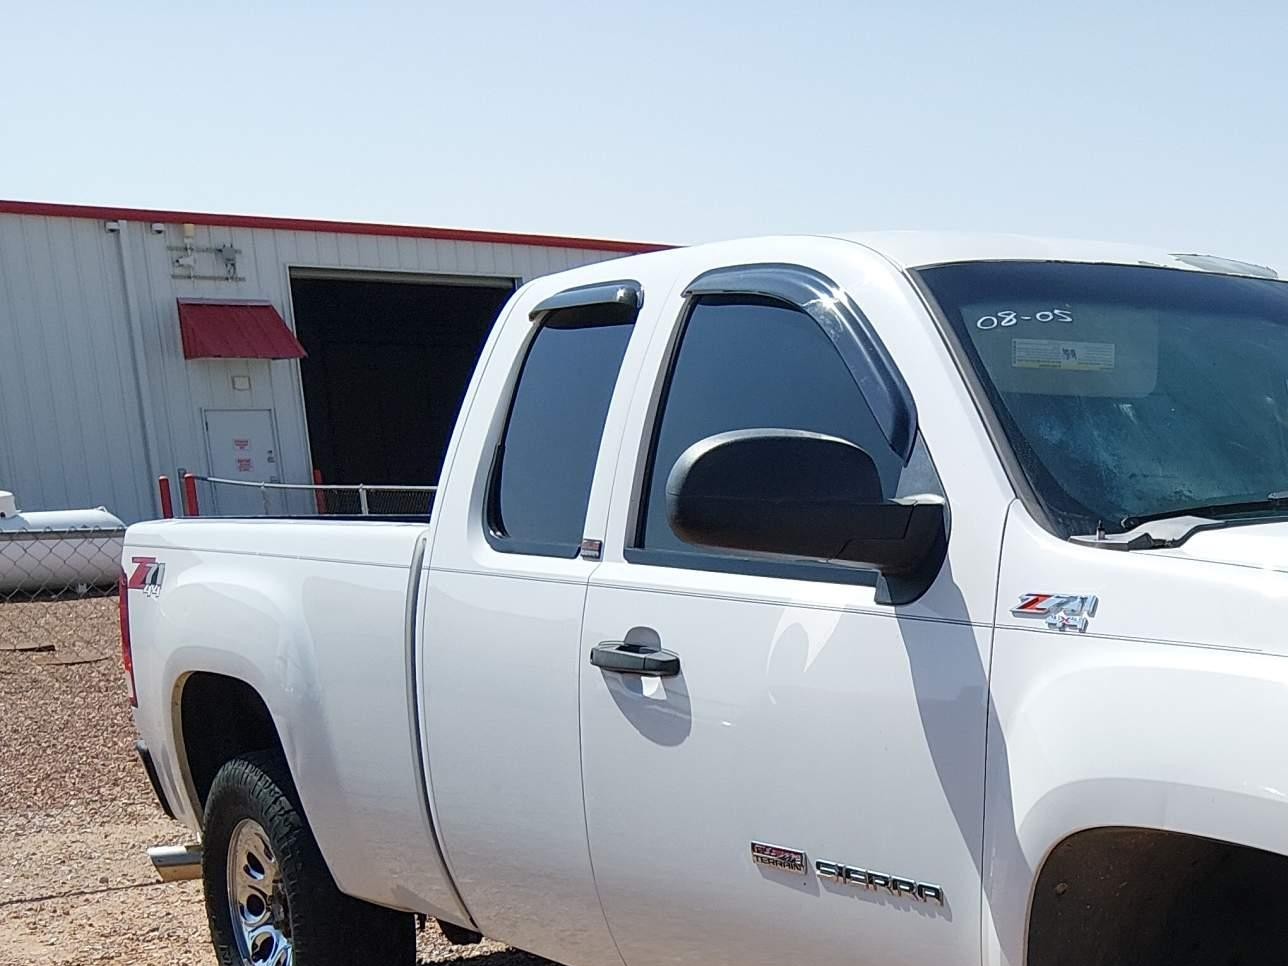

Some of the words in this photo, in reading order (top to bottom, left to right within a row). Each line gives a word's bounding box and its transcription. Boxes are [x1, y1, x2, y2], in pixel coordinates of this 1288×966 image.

[976, 308, 1073, 330] 08-05
[753, 854, 805, 872] TERRAIN
[815, 858, 945, 907] SIERRA
